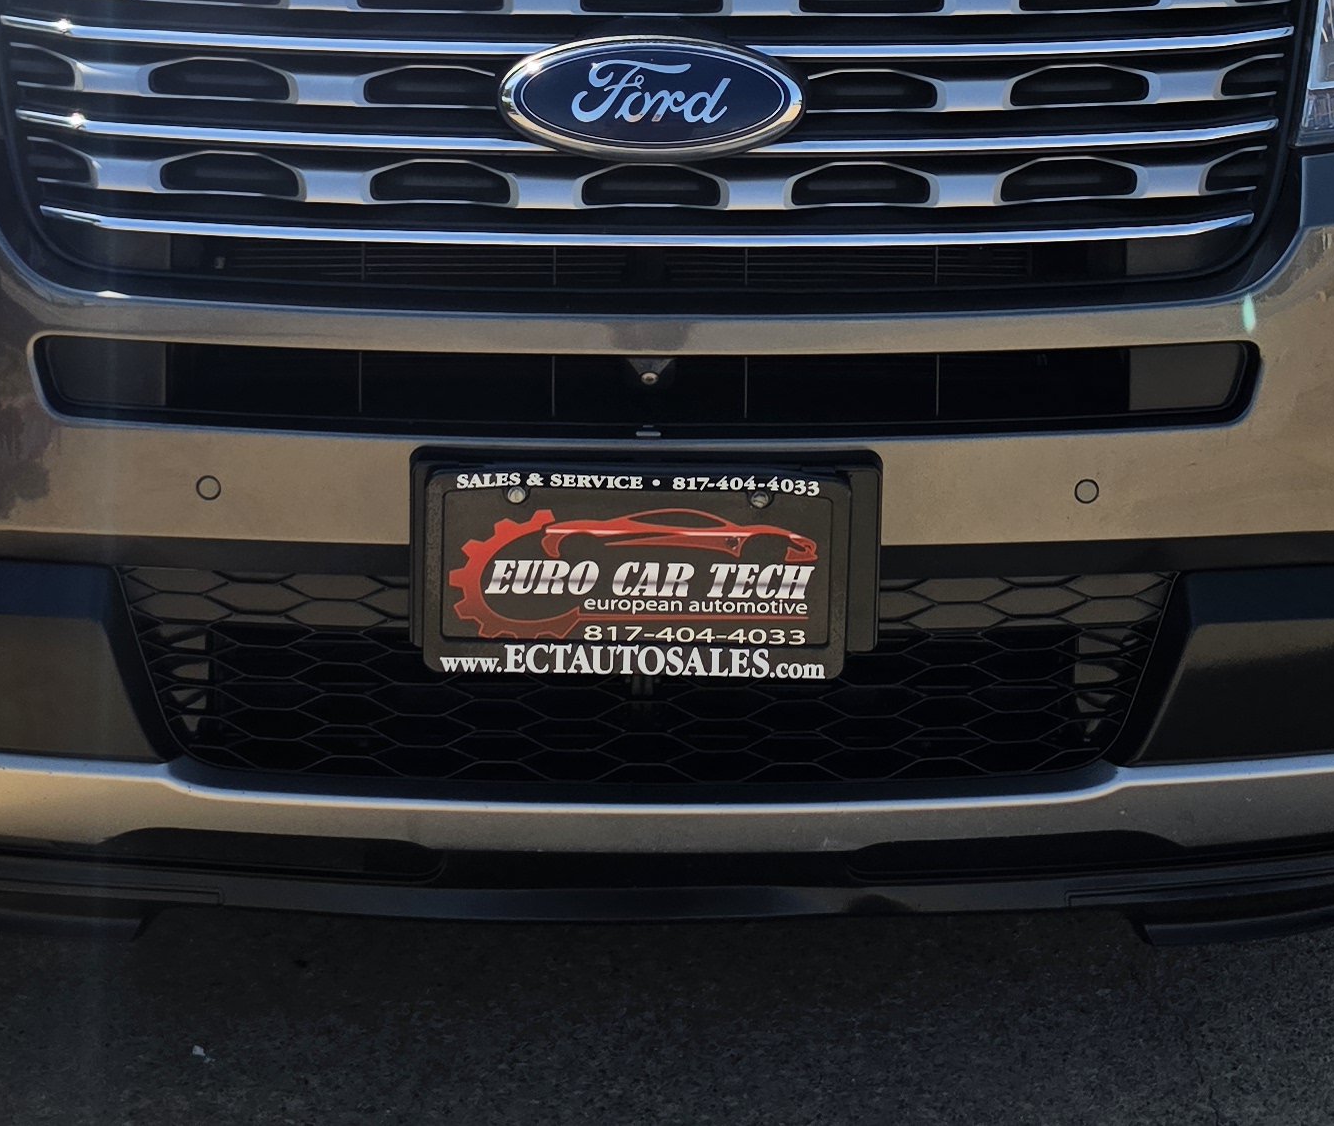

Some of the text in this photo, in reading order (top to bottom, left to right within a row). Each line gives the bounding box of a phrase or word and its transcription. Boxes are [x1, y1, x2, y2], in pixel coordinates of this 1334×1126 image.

[571, 59, 732, 123] Ford
[456, 472, 820, 496] SALES & SERVICE 817-404-4033
[486, 560, 816, 599] EURO CAR TECH
[584, 597, 808, 616] european automotive
[583, 625, 806, 646] 817-404-4033
[440, 643, 825, 679] www.ECTAUTOSALES.com
